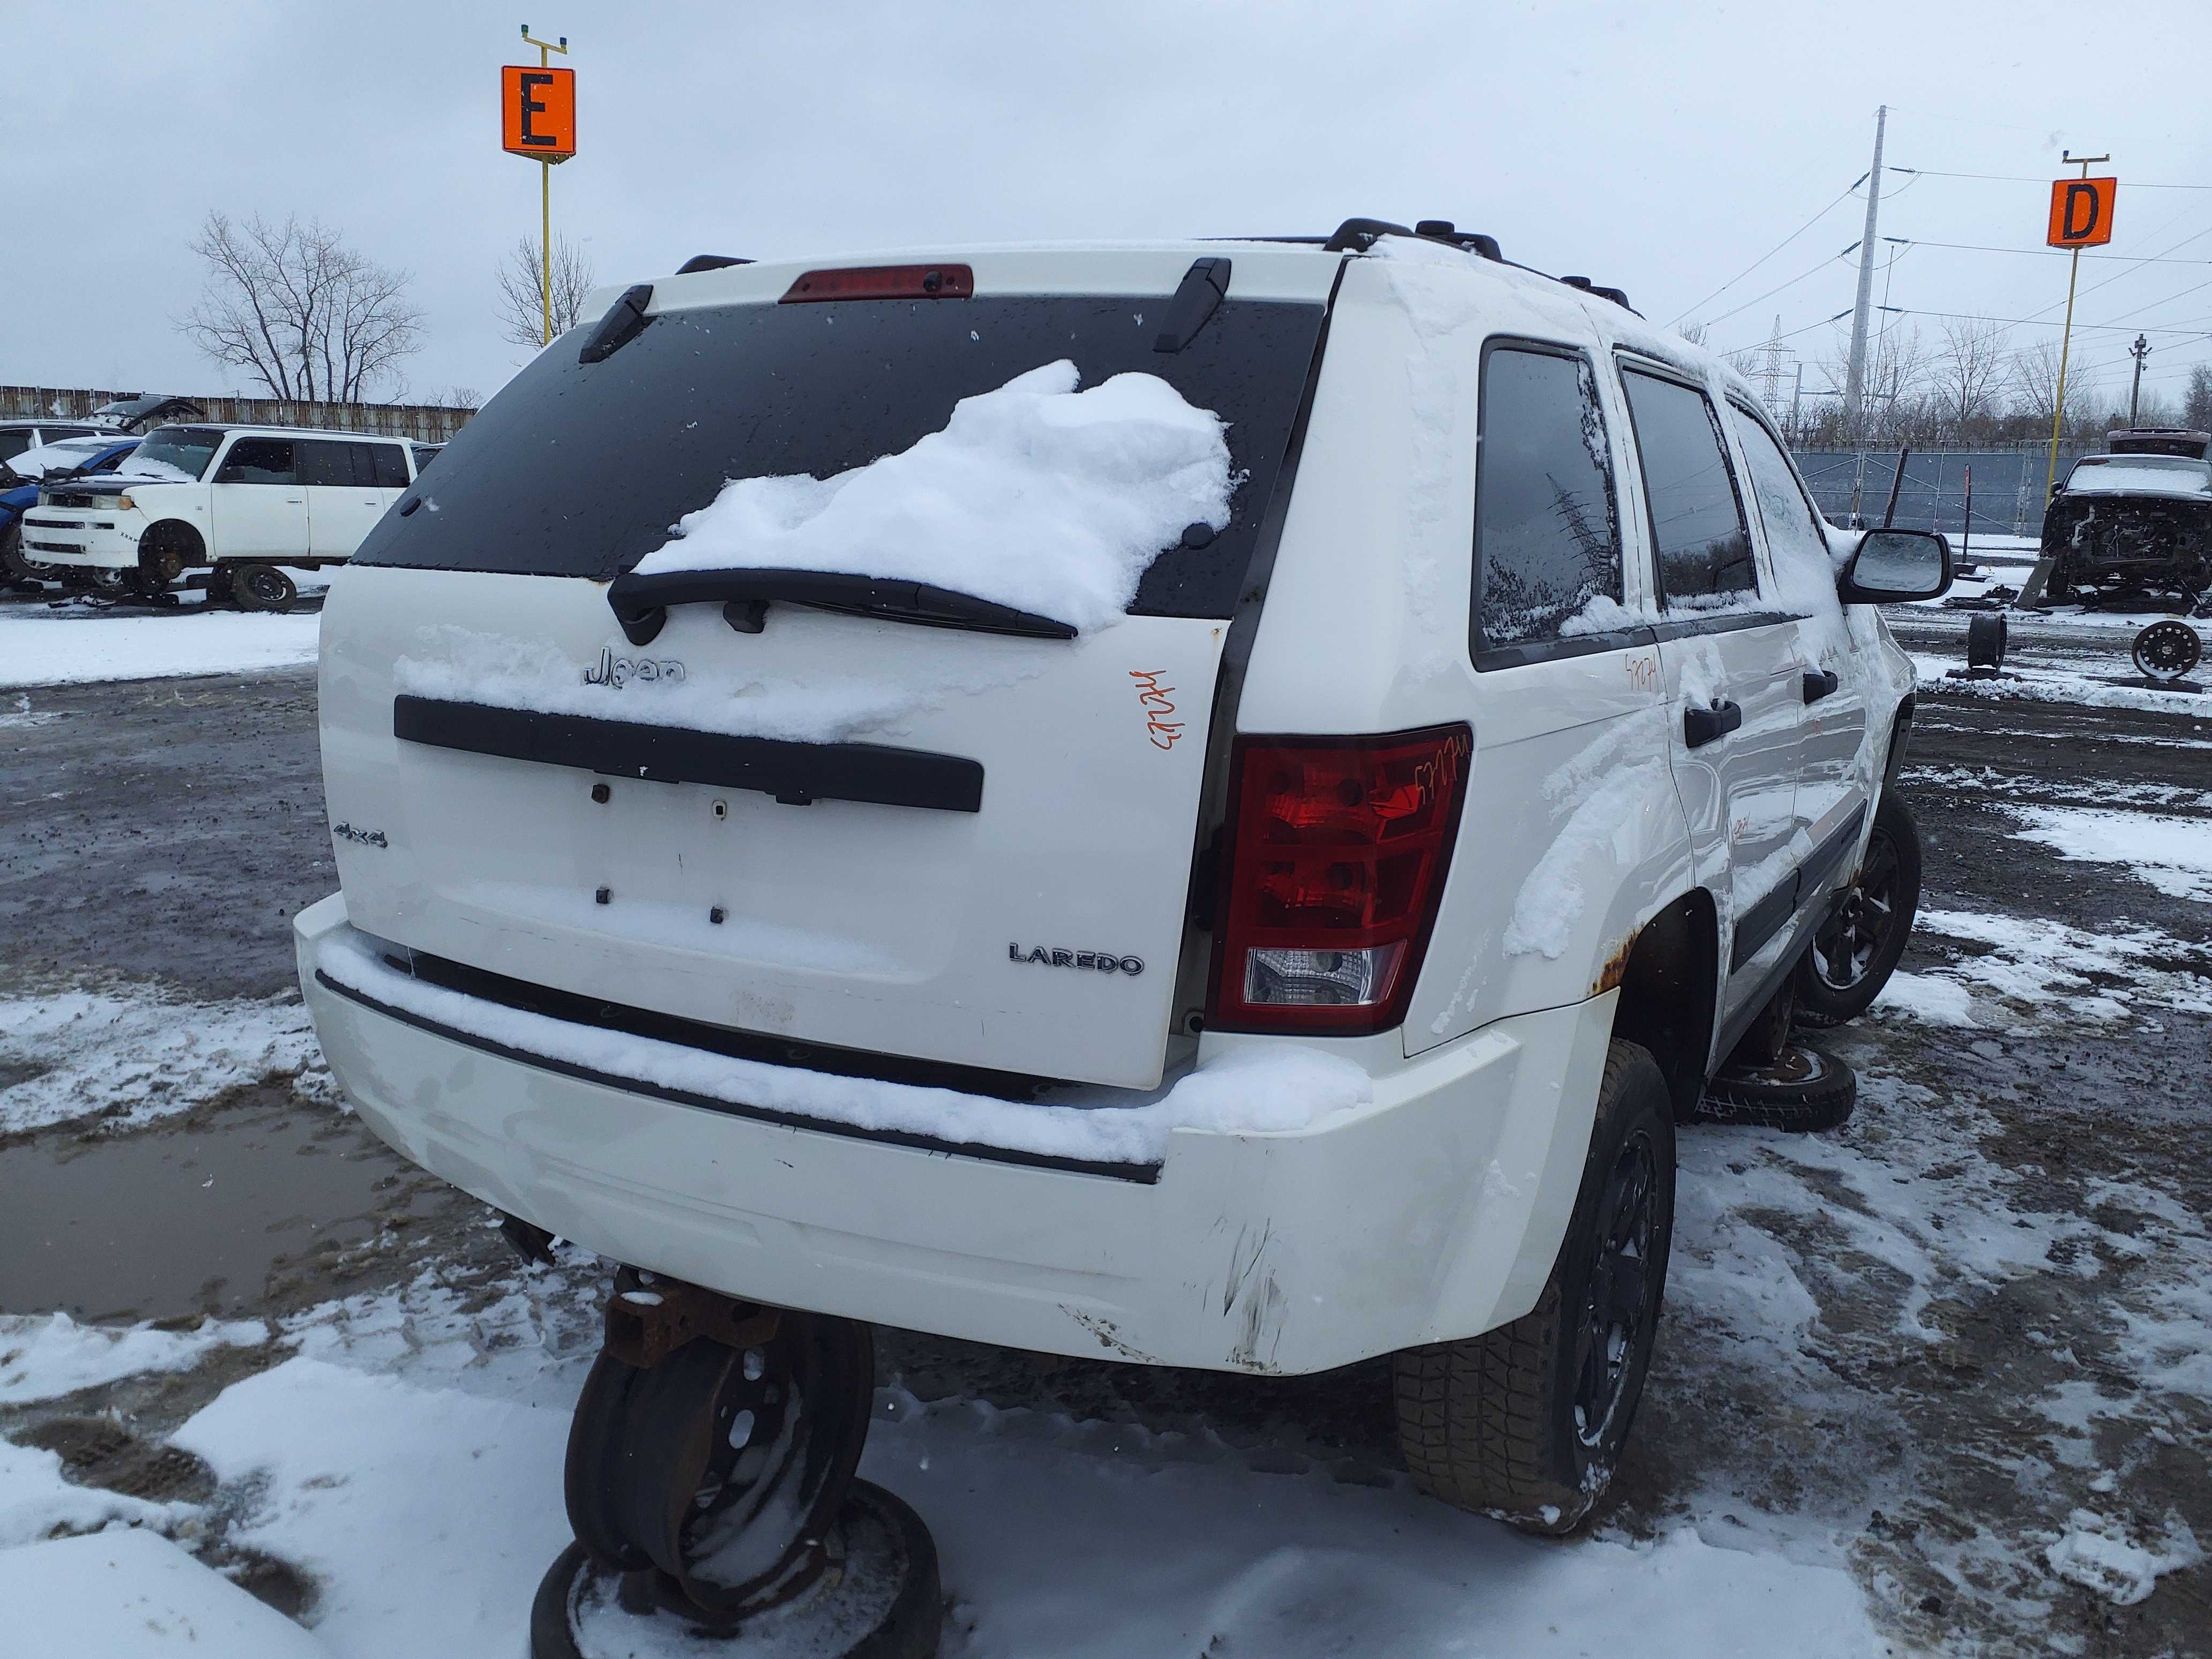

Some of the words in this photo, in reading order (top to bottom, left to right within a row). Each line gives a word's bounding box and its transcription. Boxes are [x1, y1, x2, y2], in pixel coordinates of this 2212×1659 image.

[521, 73, 557, 146] E
[2062, 184, 2099, 240] D
[333, 821, 388, 849] 4x4
[1009, 942, 1145, 975] LAREDO
